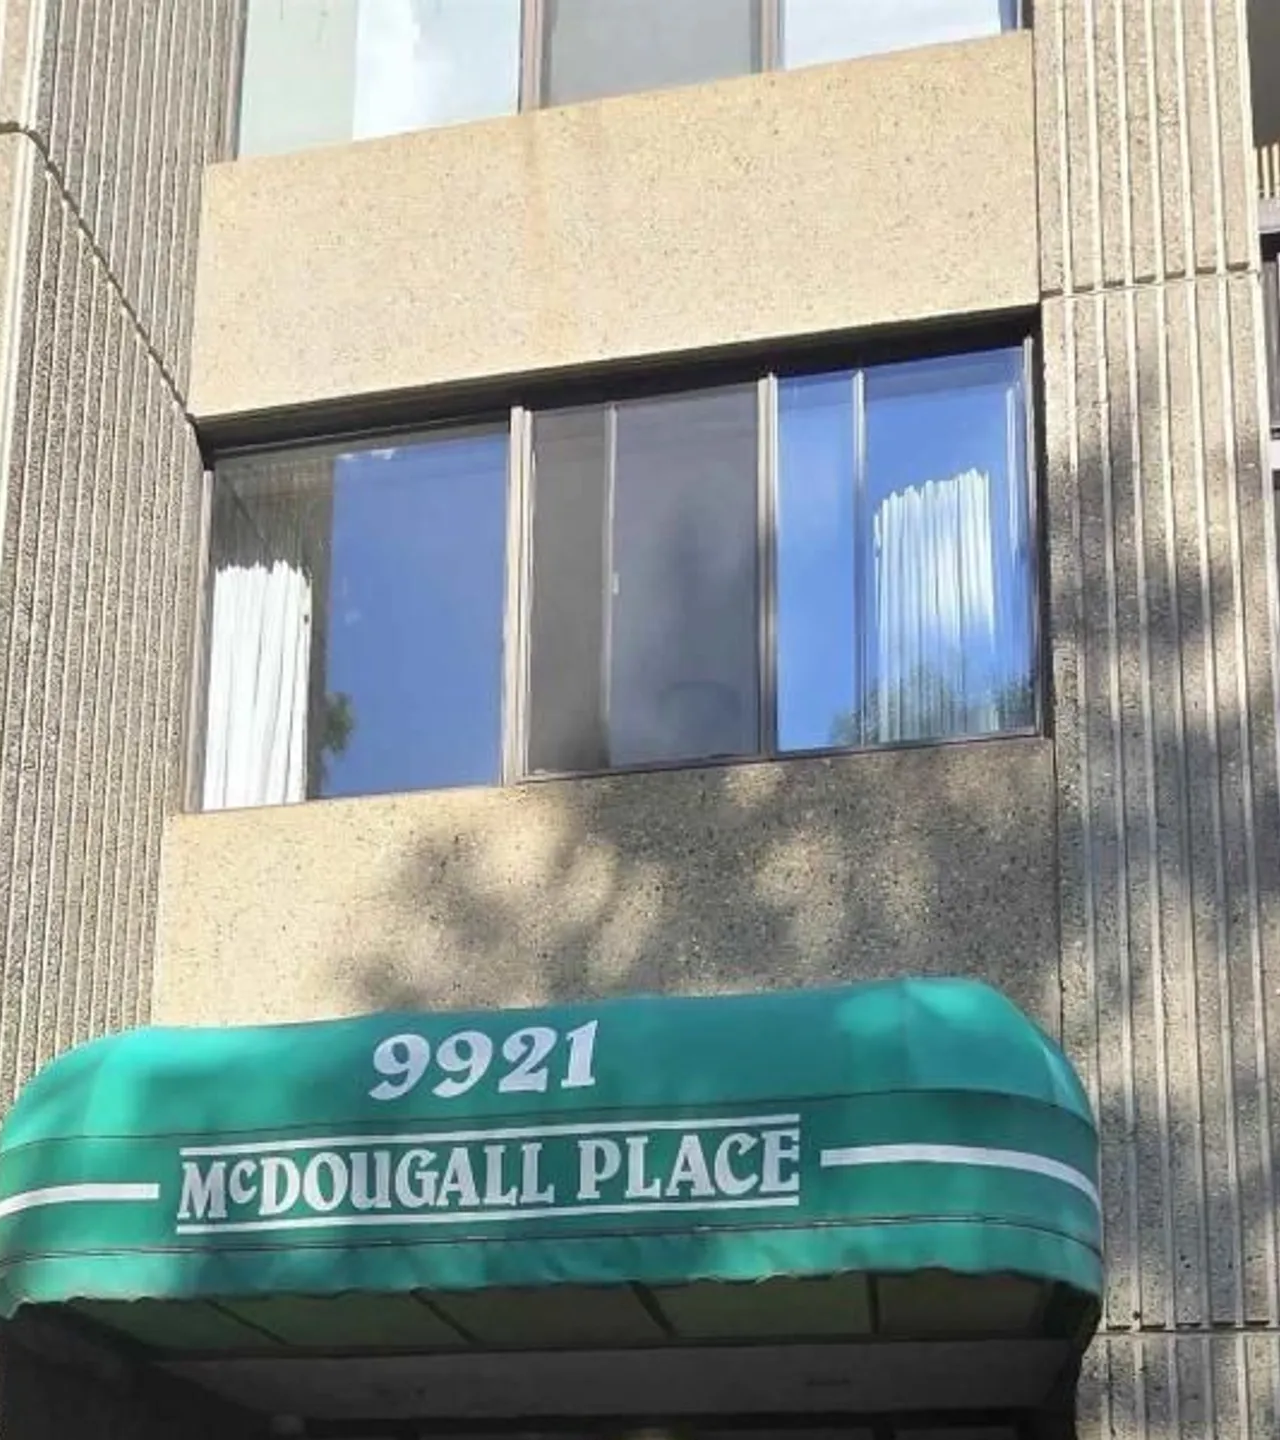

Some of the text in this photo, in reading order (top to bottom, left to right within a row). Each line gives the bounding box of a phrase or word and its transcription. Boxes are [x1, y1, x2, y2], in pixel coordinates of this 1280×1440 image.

[368, 1020, 598, 1100] 9921
[177, 1128, 800, 1220] McDOUGALL PLACE
